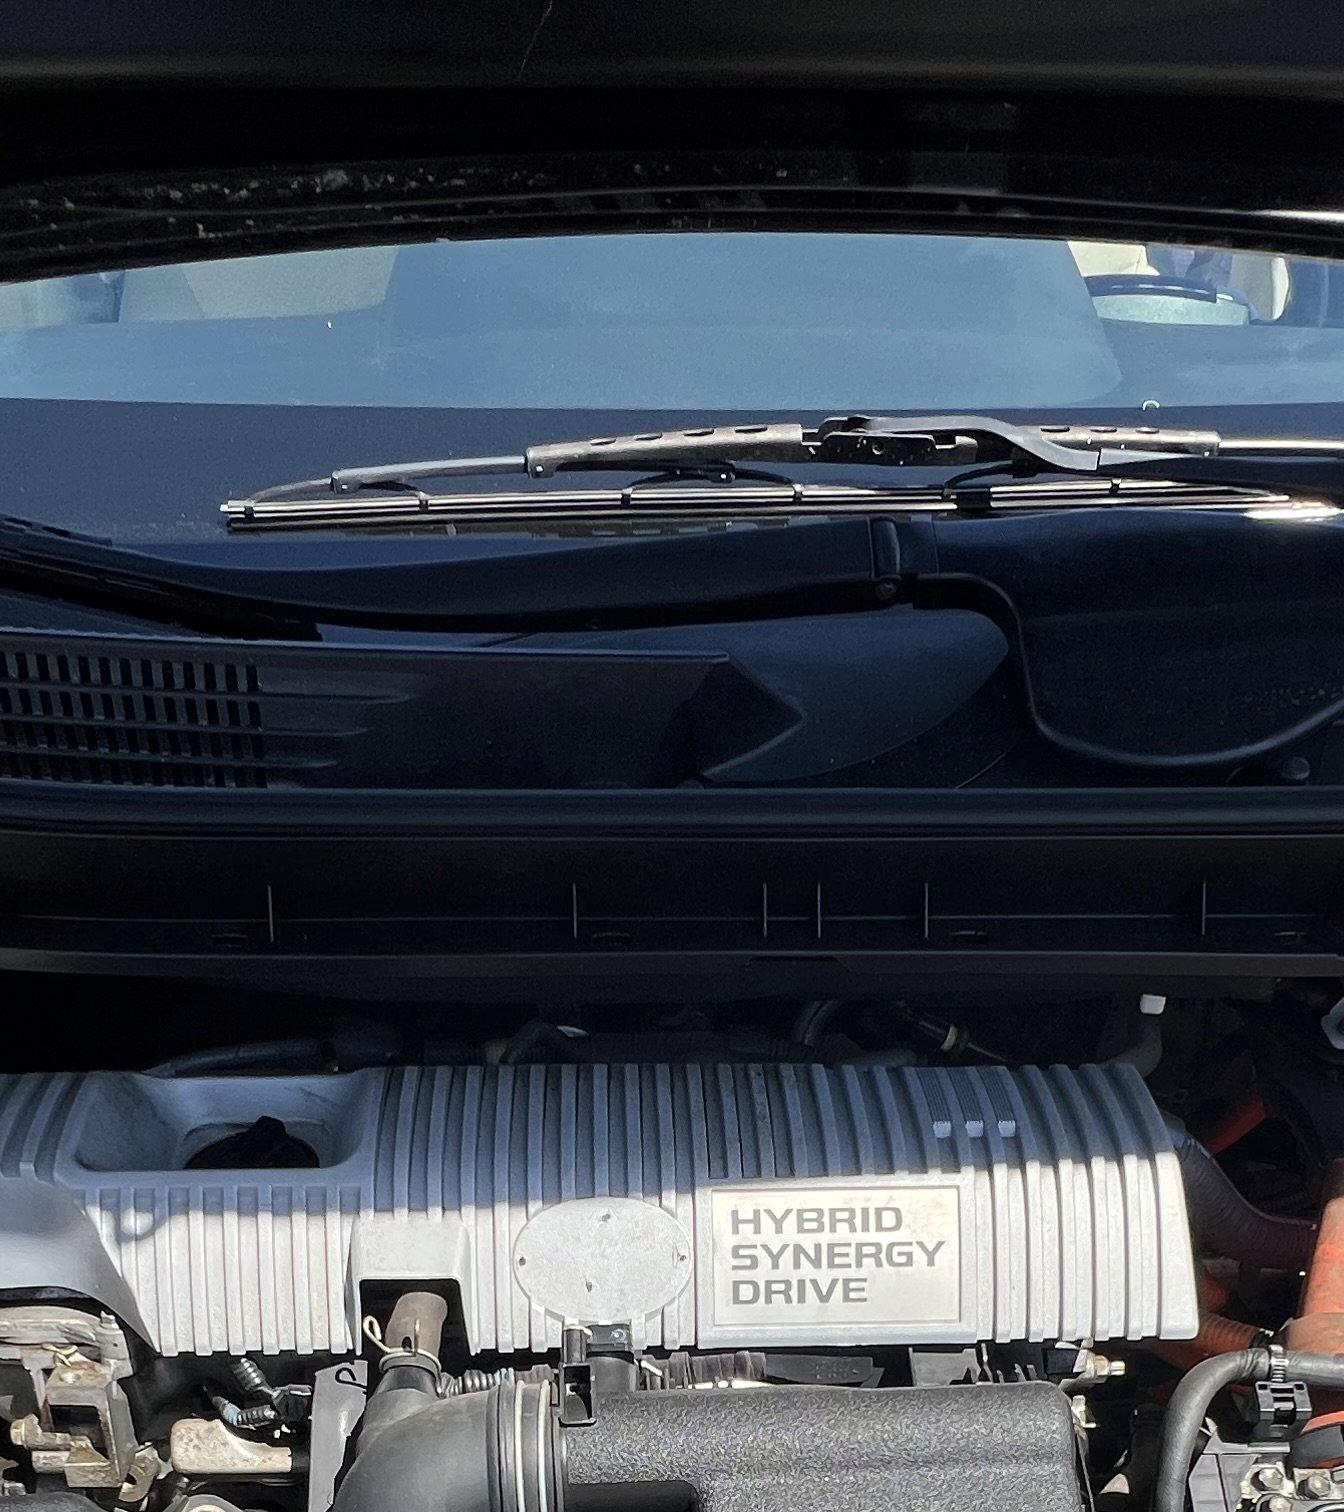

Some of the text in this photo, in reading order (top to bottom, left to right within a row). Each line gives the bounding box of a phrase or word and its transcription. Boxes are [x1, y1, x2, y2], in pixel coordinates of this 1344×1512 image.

[731, 1207, 903, 1235] HYBRID
[731, 1240, 946, 1271] SYNERGY
[731, 1278, 868, 1305] DRIVE
